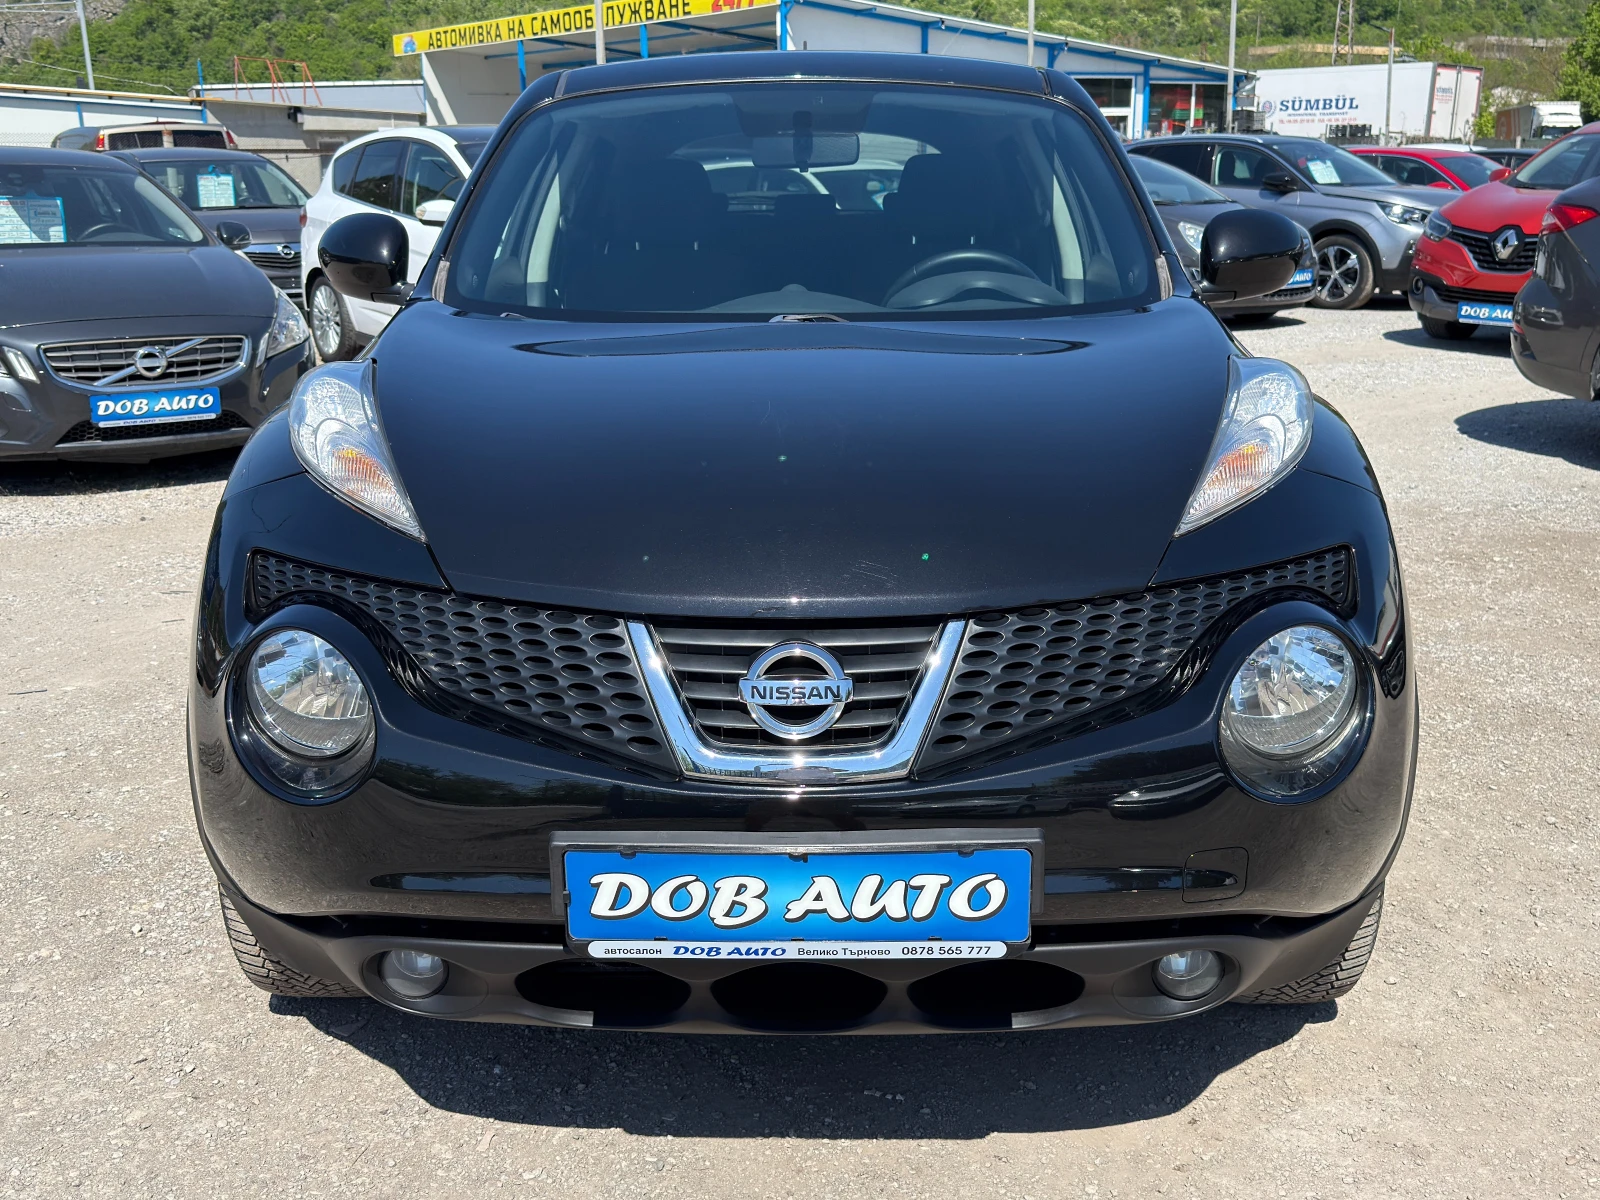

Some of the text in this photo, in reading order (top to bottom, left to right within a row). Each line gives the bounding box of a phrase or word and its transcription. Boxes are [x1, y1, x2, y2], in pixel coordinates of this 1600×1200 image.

[428, 0, 692, 50] АВТОМИВКА НА САМООБЛУЖВАНЕ
[1279, 94, 1359, 112] SÜMBÜL
[1460, 305, 1513, 320] DOB AU
[96, 393, 214, 416] DOB AUTO
[750, 685, 841, 700] NISSAN
[589, 872, 1008, 930] DOB AUTO
[603, 945, 992, 957] автосалон DOB AUTO Велико Търново 0878 565 777
